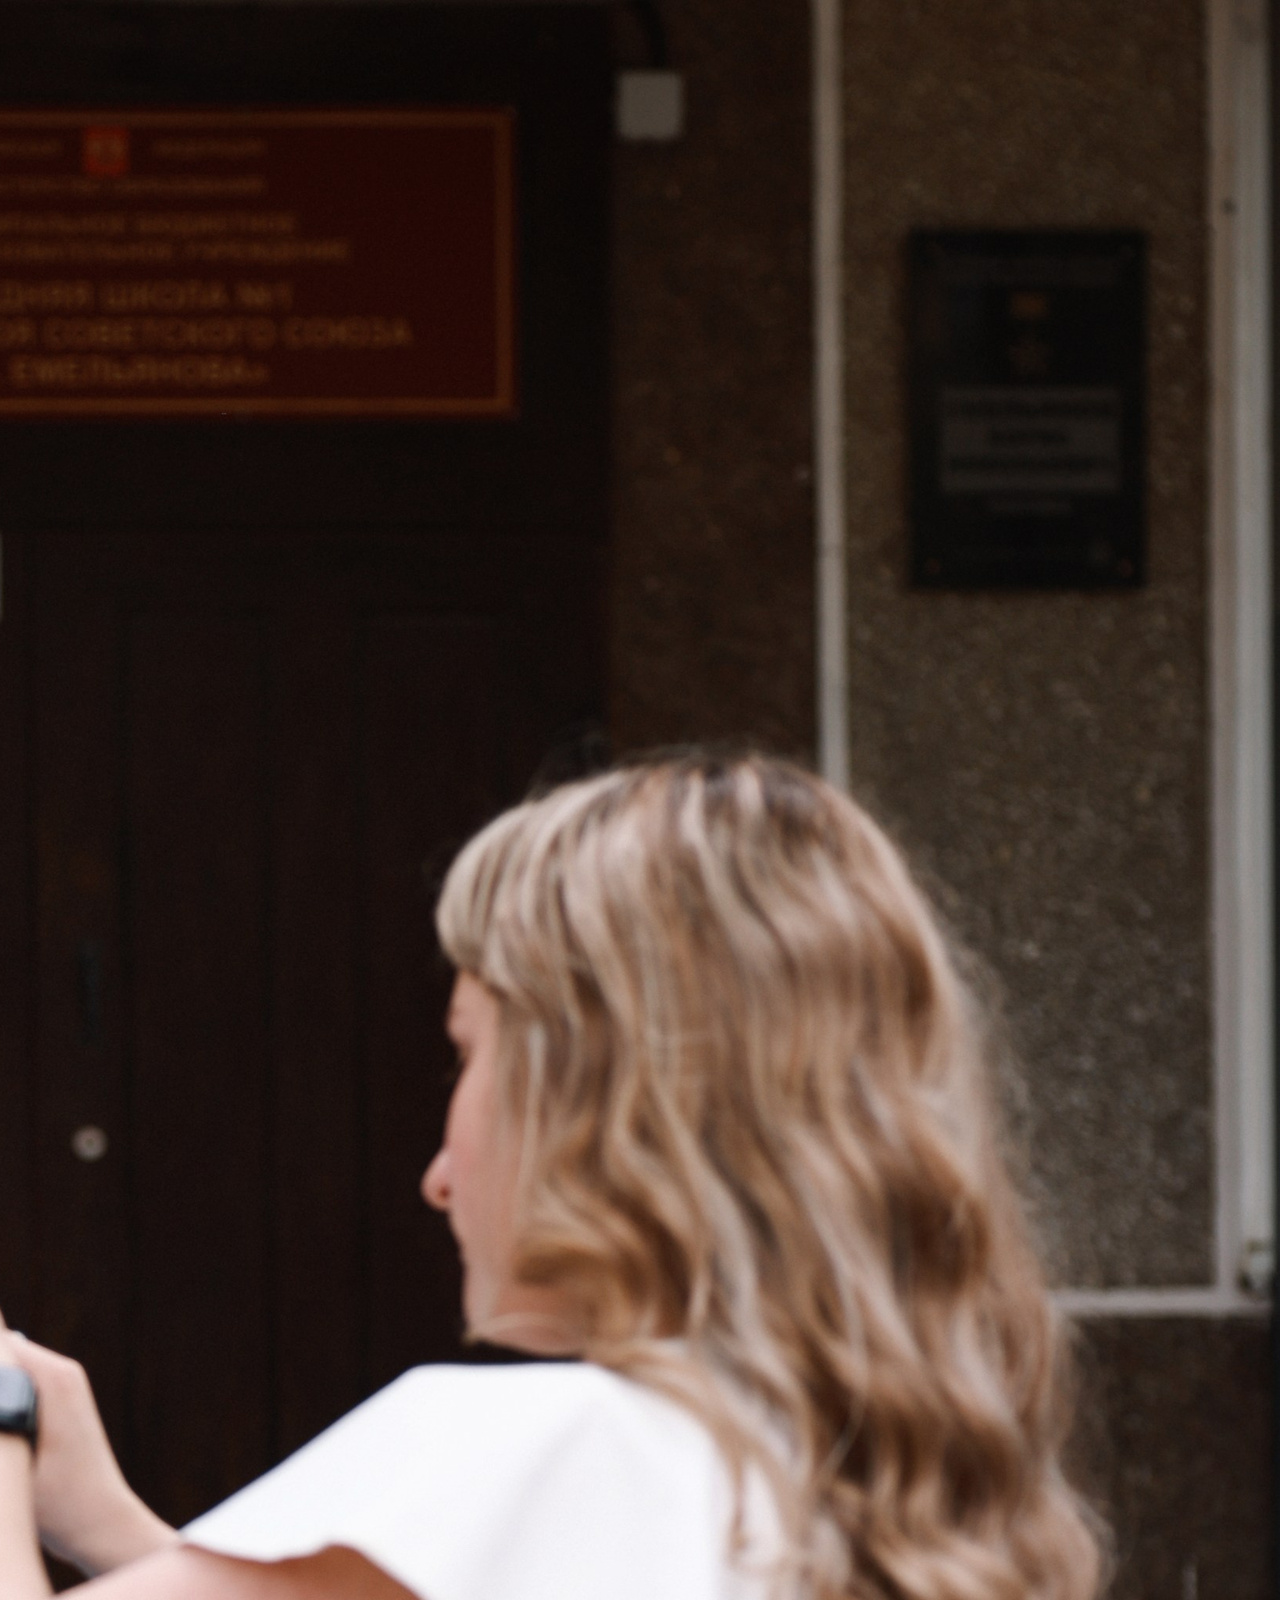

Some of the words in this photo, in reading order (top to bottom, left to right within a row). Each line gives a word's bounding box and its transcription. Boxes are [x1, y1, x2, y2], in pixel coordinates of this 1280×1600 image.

[103, 280, 229, 311] ШКОЛА
[43, 317, 276, 349] СОВЕТСКОГО
[283, 317, 413, 349] СОЮЗА
